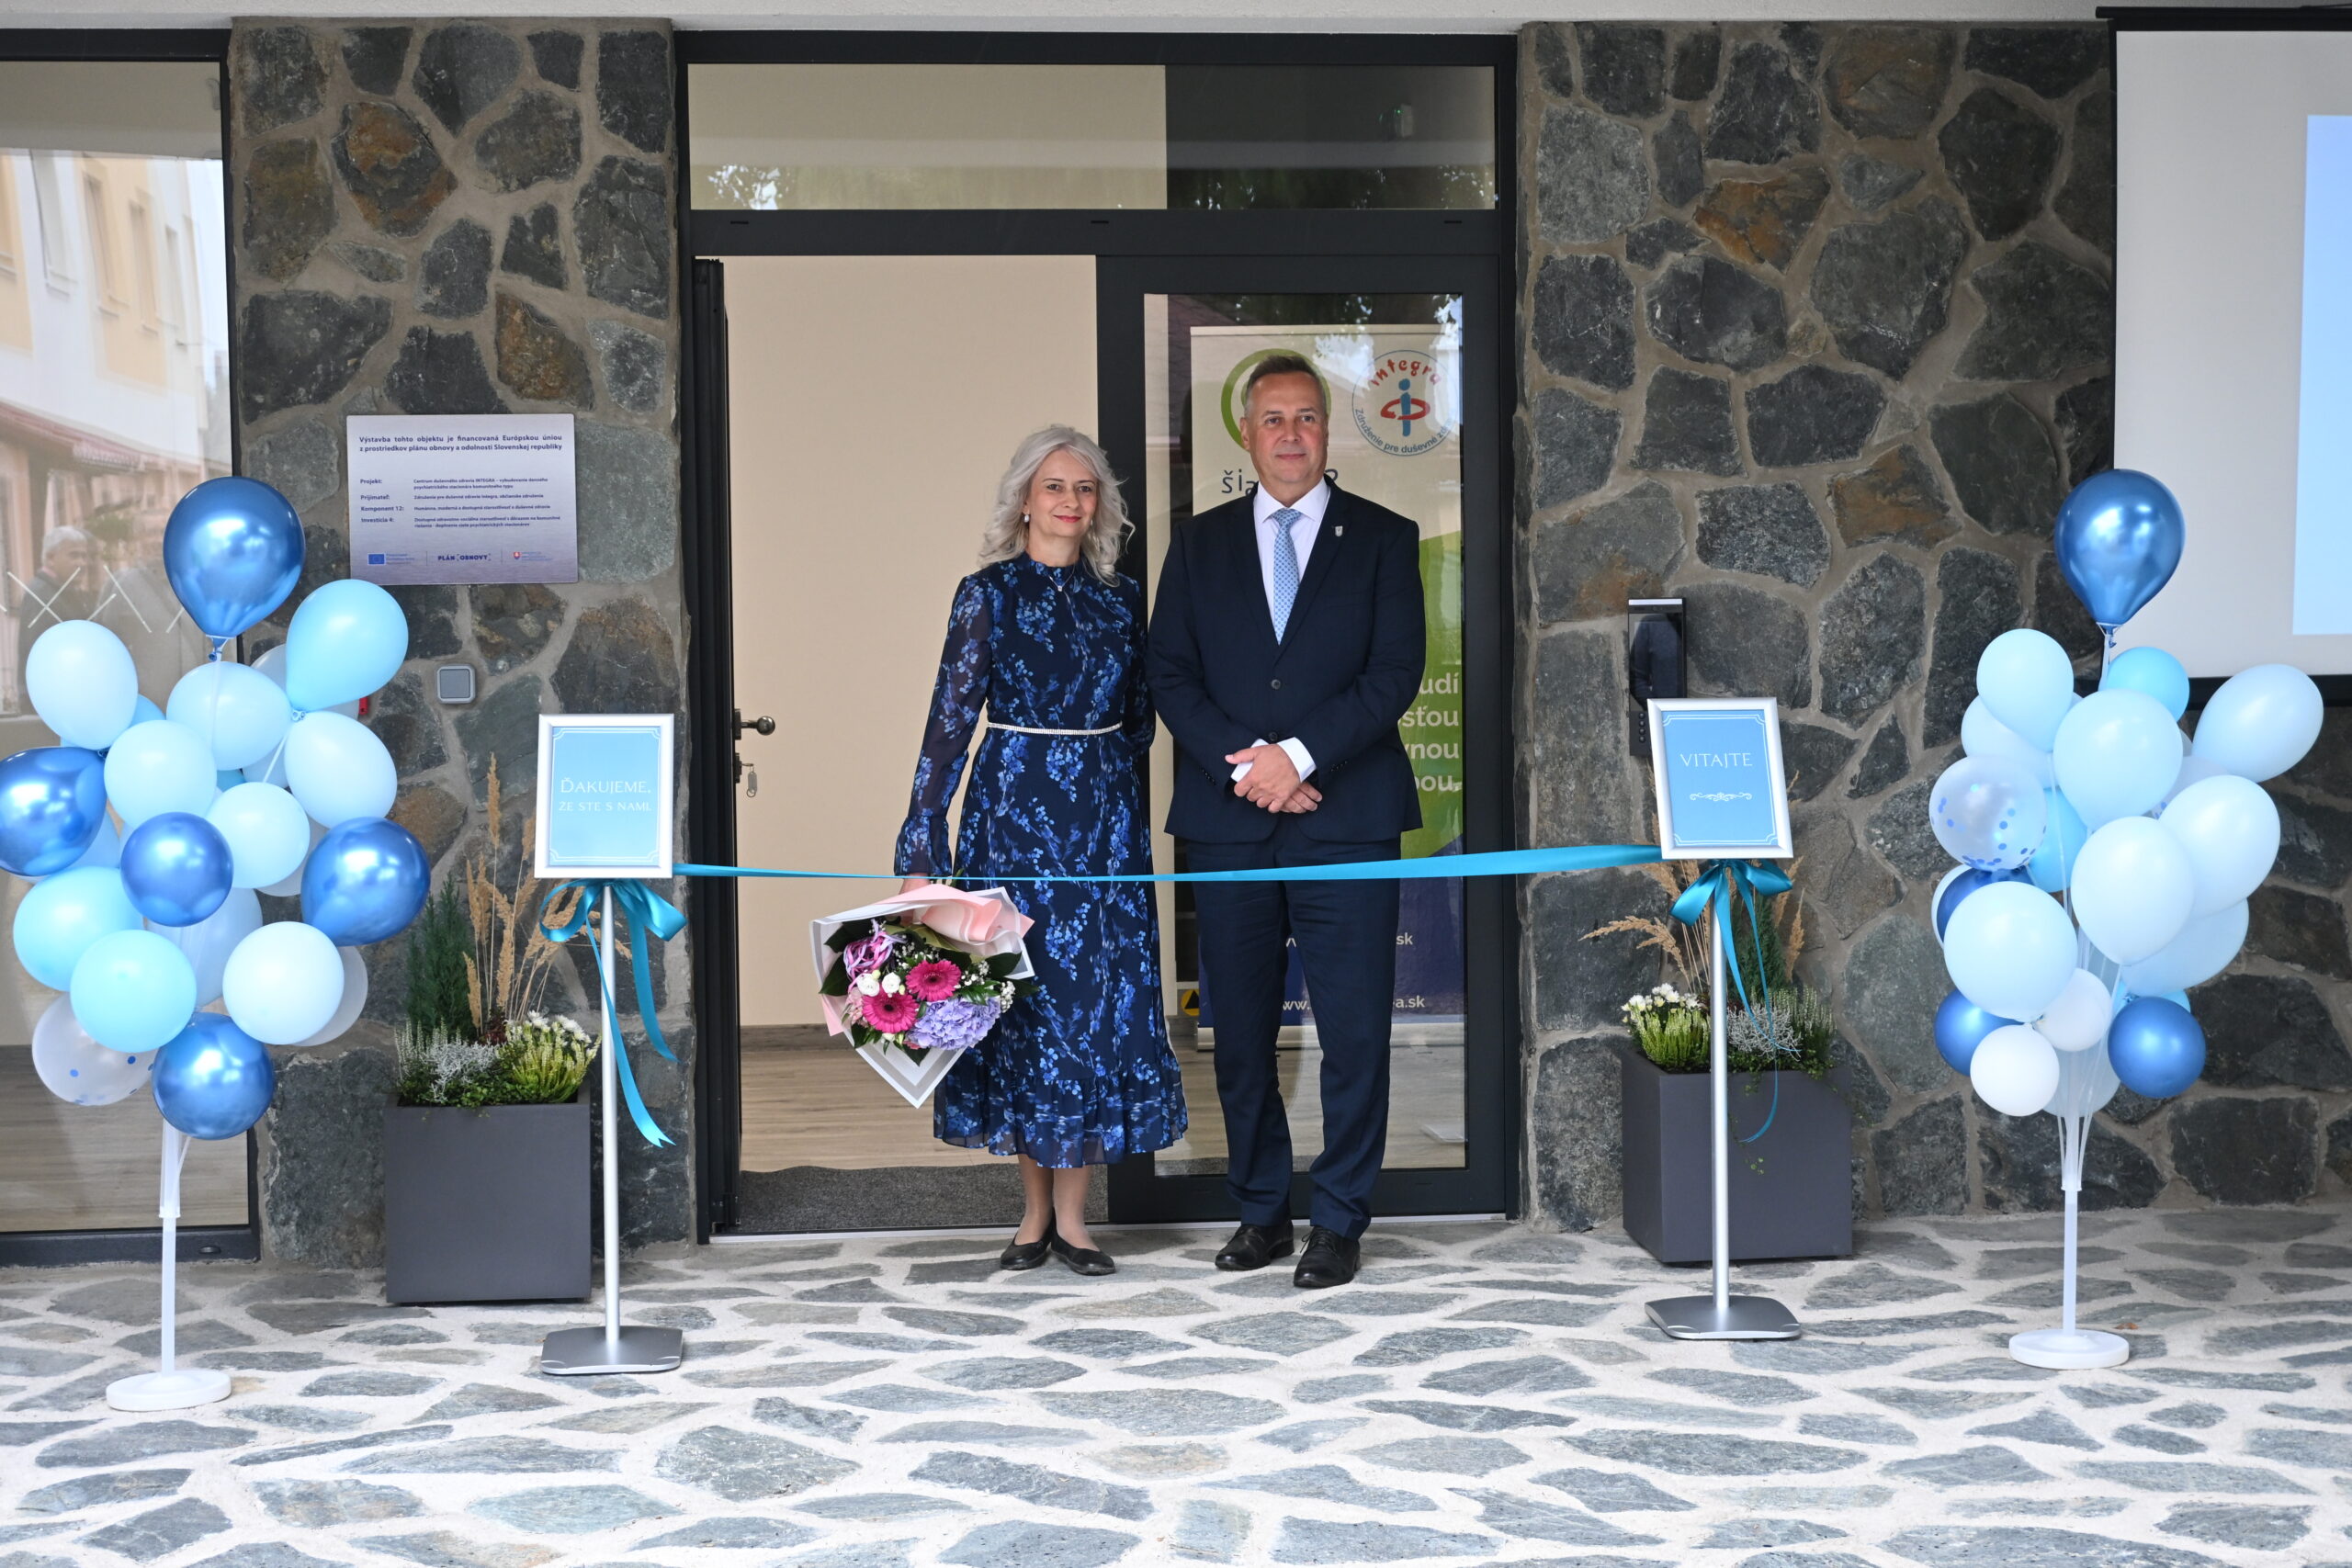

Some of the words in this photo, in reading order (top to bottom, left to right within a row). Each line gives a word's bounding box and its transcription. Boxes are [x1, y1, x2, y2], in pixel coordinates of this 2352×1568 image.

[1368, 359, 1442, 387] integra
[416, 435, 444, 444] objektu
[1354, 408, 1383, 446] Združenie
[1384, 444, 1399, 453] pre
[1401, 436, 1438, 454] duševné
[365, 445, 407, 453] prostriedkov
[531, 443, 562, 451] republiky
[437, 553, 456, 561] PLÁN
[1419, 671, 1459, 694] udí
[1398, 705, 1459, 727] sťou
[1406, 742, 1459, 760] nou
[1679, 752, 1753, 769] VITAJTE
[578, 801, 602, 812] STE
[606, 801, 613, 812] S
